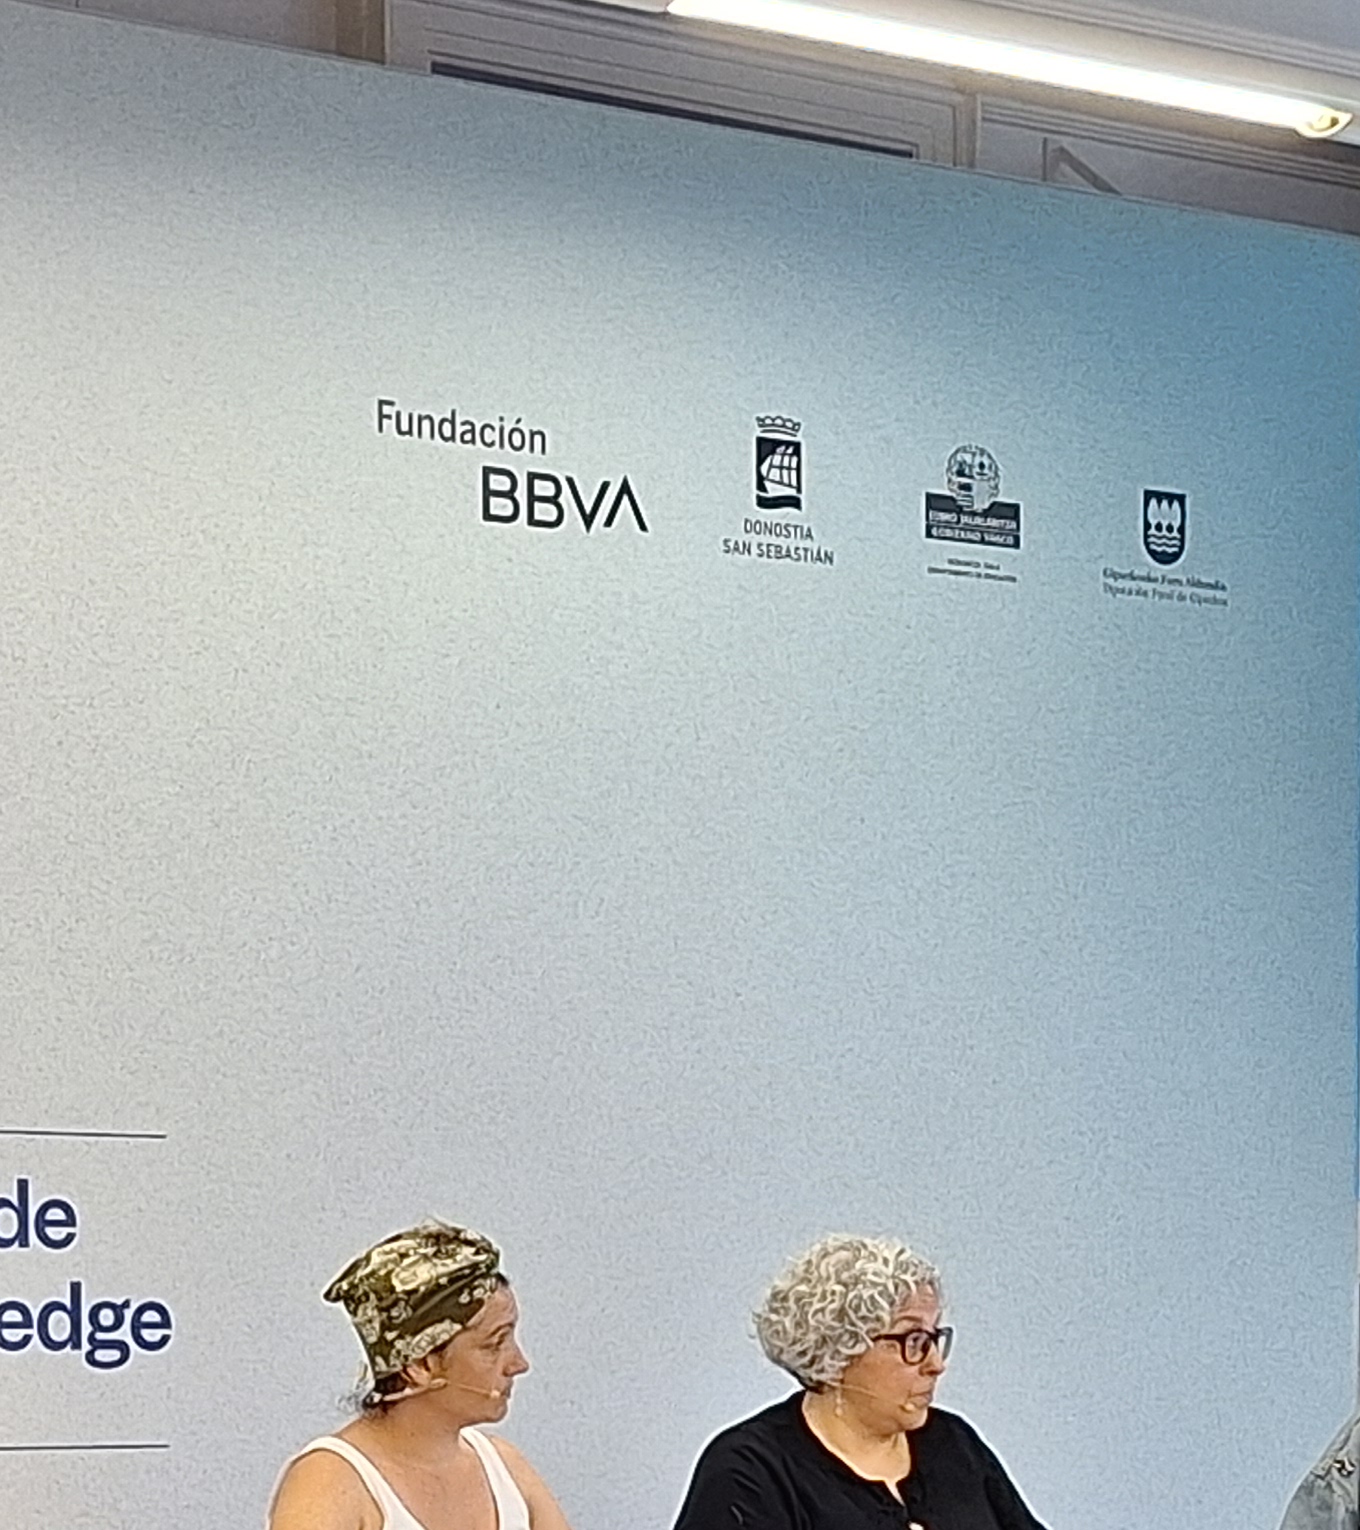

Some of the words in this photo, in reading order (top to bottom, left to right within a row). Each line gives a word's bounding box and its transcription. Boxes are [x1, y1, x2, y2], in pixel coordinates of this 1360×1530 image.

[377, 398, 547, 455] Fundación
[482, 465, 649, 533] BBVA
[744, 517, 813, 541] DONOSTIA
[722, 538, 751, 556] SAN
[756, 541, 835, 566] SEBASTIÁN
